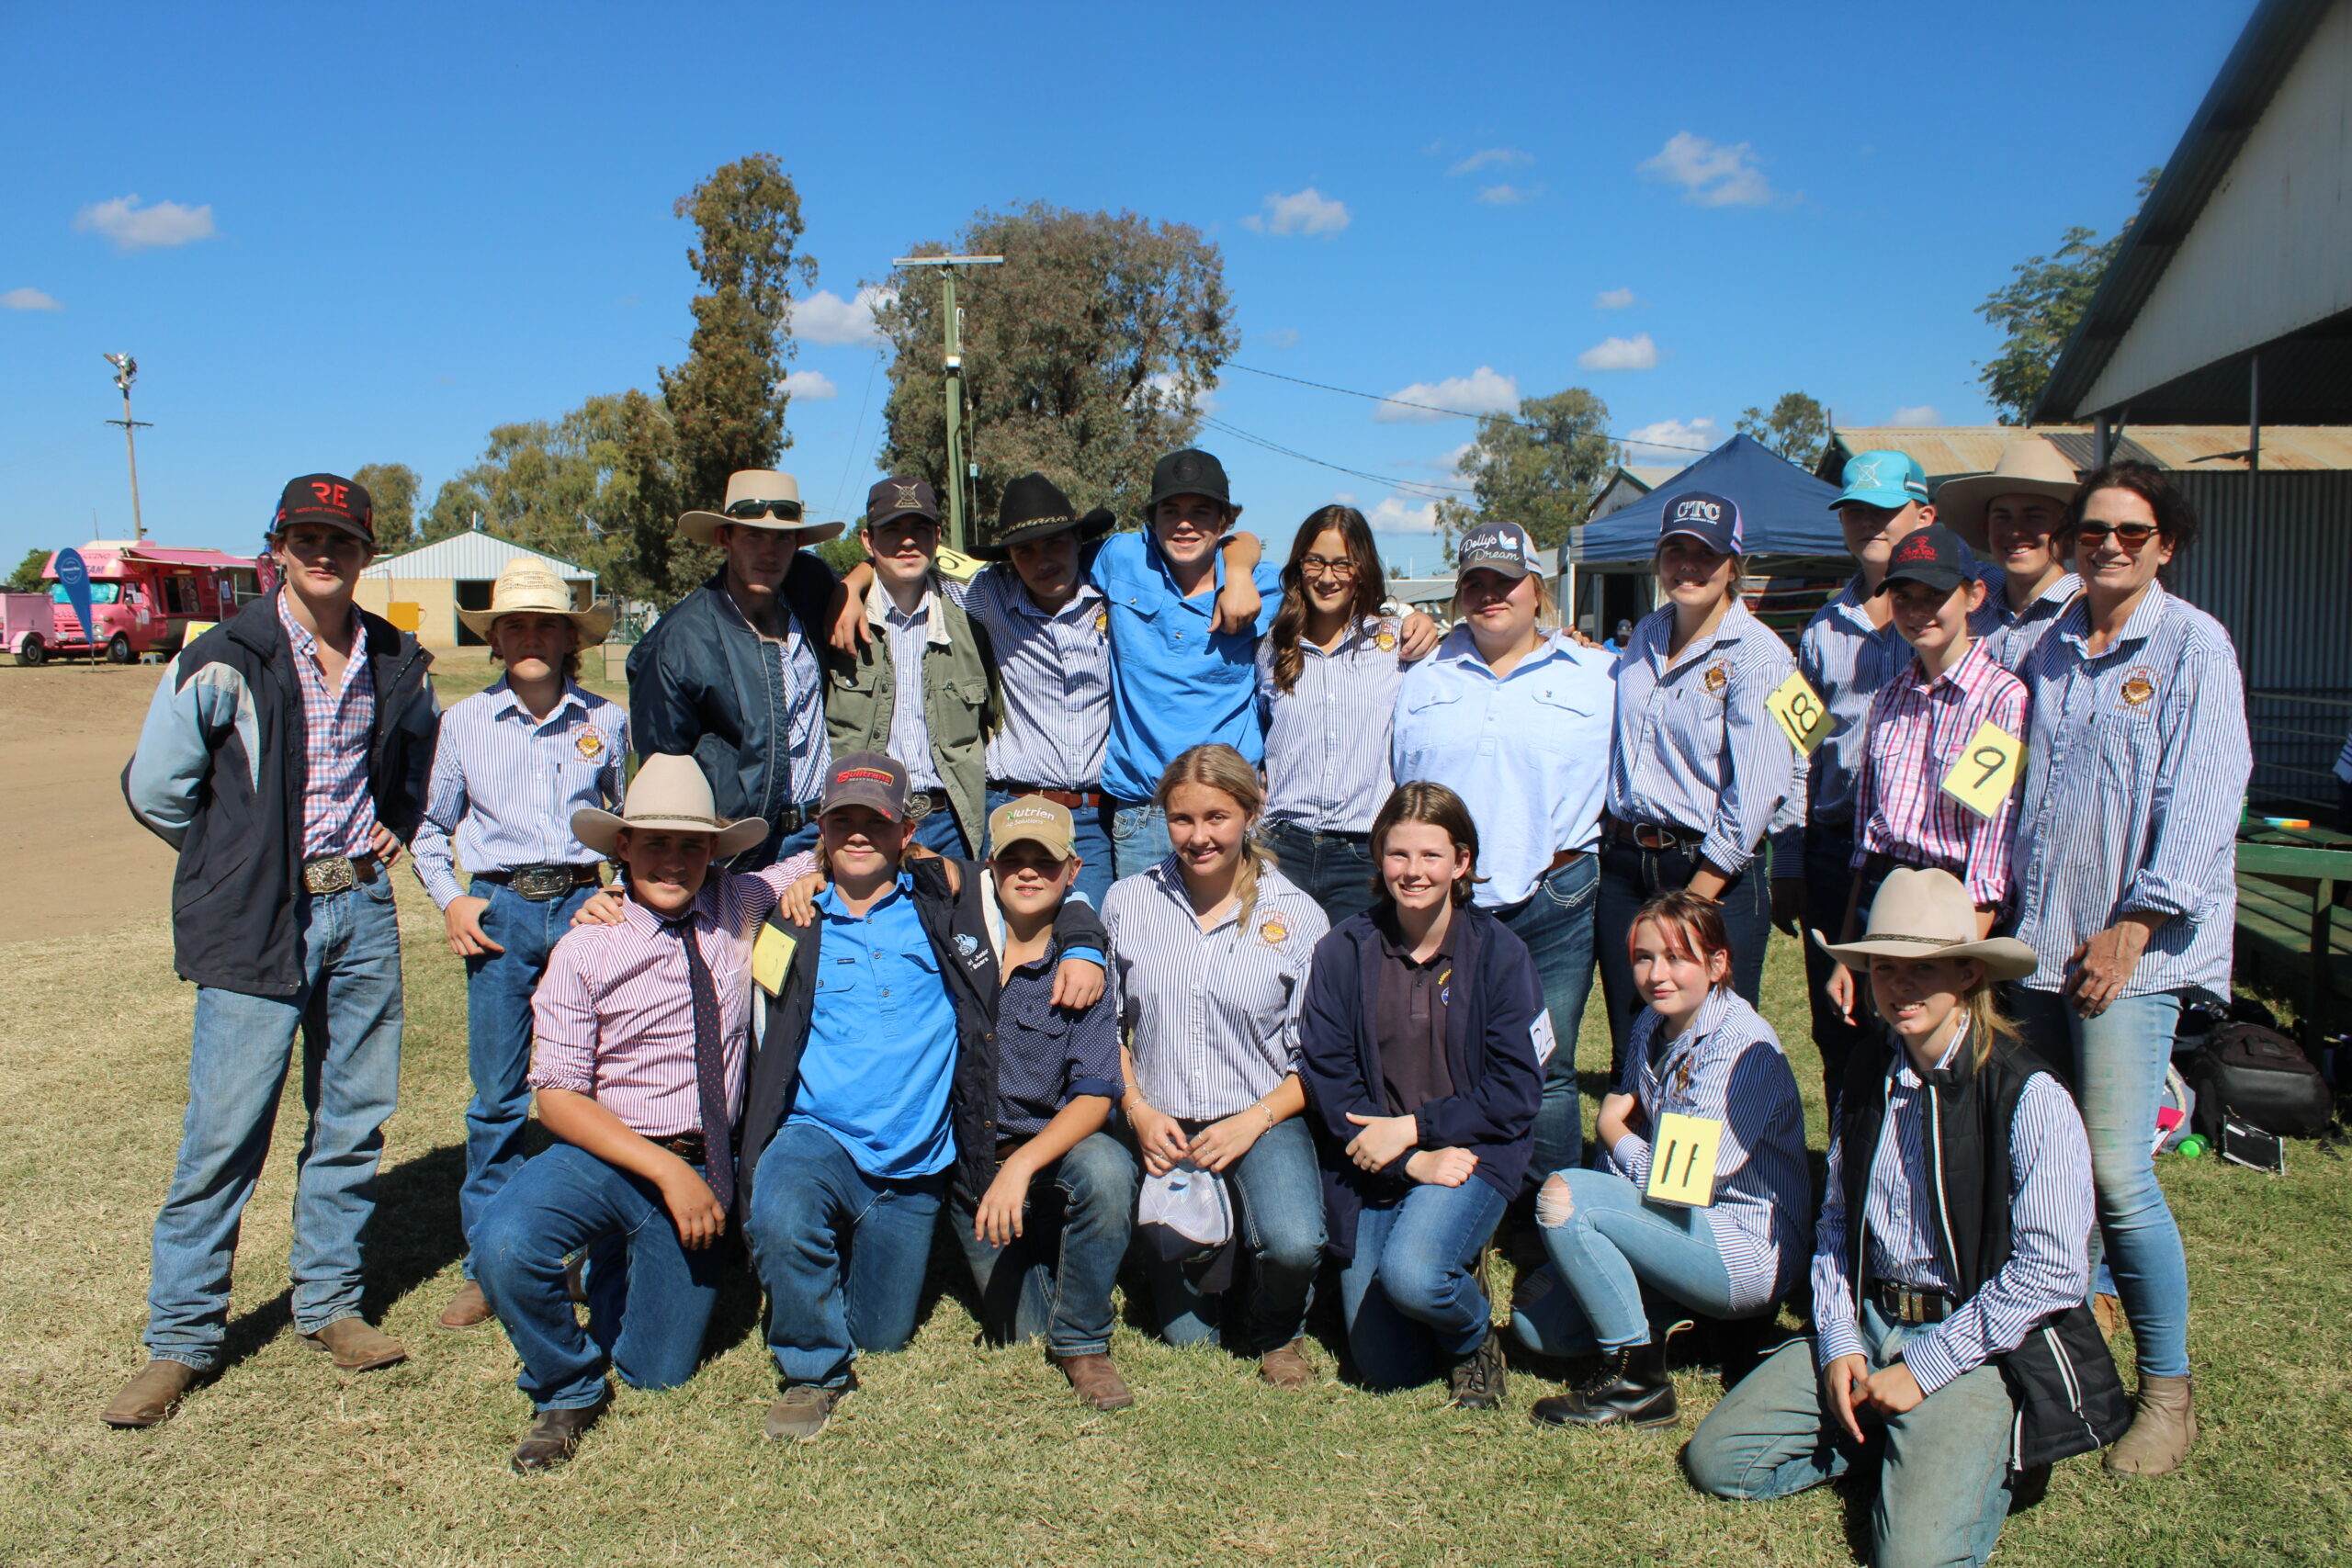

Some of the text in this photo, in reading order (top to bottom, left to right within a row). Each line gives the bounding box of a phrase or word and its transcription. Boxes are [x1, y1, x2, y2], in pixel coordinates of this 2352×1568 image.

[311, 482, 349, 508] RE
[1678, 501, 1721, 521] CTC
[1461, 534, 1498, 553] Dolly's
[1468, 548, 1520, 562] Dream
[86, 566, 105, 574] EAM
[1781, 692, 1818, 745] 18
[1973, 745, 2006, 789] 9
[1007, 807, 1055, 821] Nutrien
